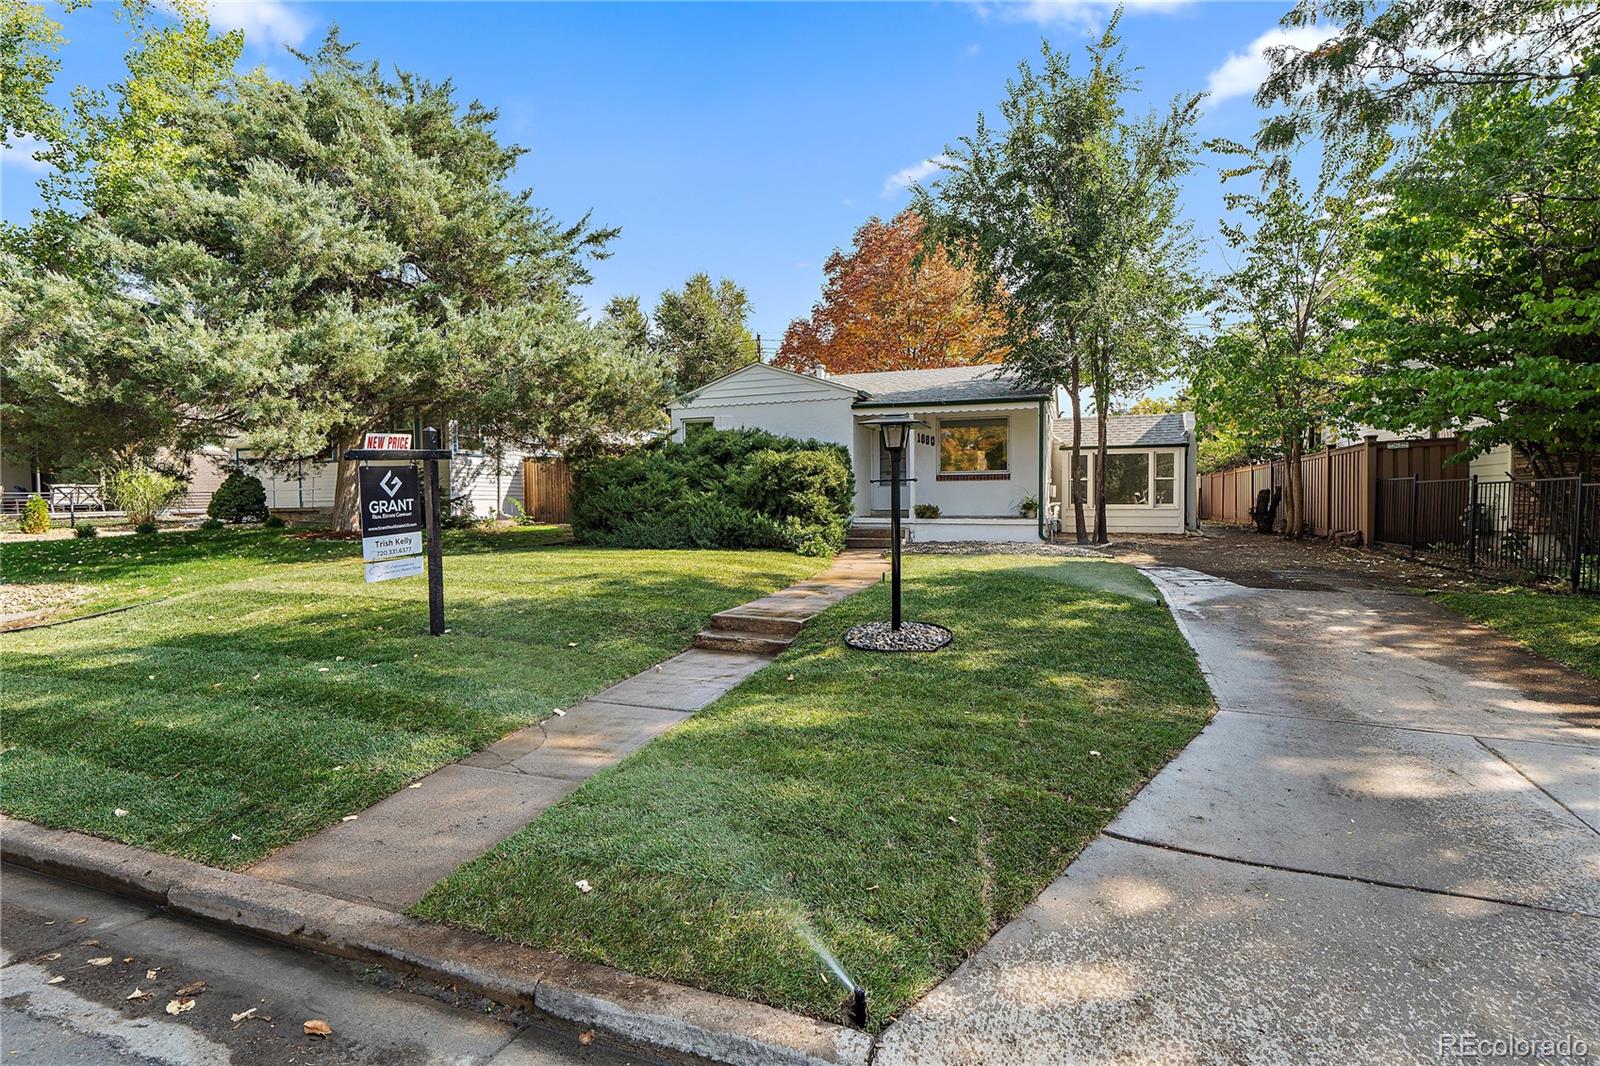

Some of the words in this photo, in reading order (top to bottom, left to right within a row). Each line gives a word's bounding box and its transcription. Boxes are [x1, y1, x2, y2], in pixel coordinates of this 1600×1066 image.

[367, 436, 385, 449] NEW
[387, 436, 409, 449] PRICE
[369, 499, 414, 513] GRANT
[375, 540, 393, 548] Trish
[395, 537, 413, 546] Kelly
